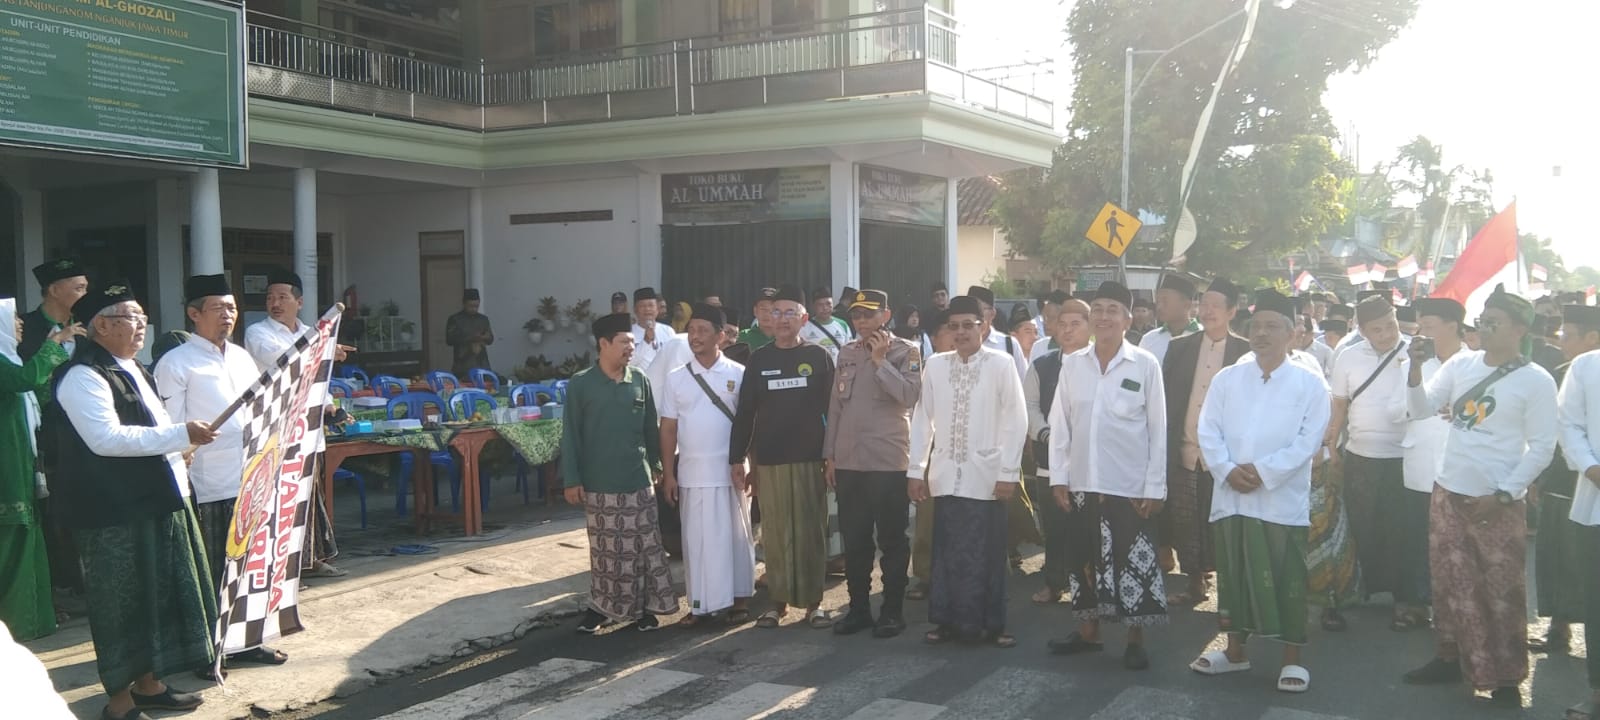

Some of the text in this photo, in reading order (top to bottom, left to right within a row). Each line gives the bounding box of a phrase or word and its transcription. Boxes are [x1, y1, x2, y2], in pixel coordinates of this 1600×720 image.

[10, 17, 61, 35] UNIT-UNIT
[62, 27, 121, 46] PENDIDIKAN
[138, 22, 161, 34] JAWA
[163, 26, 189, 39] TIMUR
[689, 172, 745, 185] TOKO BUKU
[671, 187, 691, 203] AL
[698, 183, 763, 203] UMMAH
[268, 454, 305, 615] TARUNA
